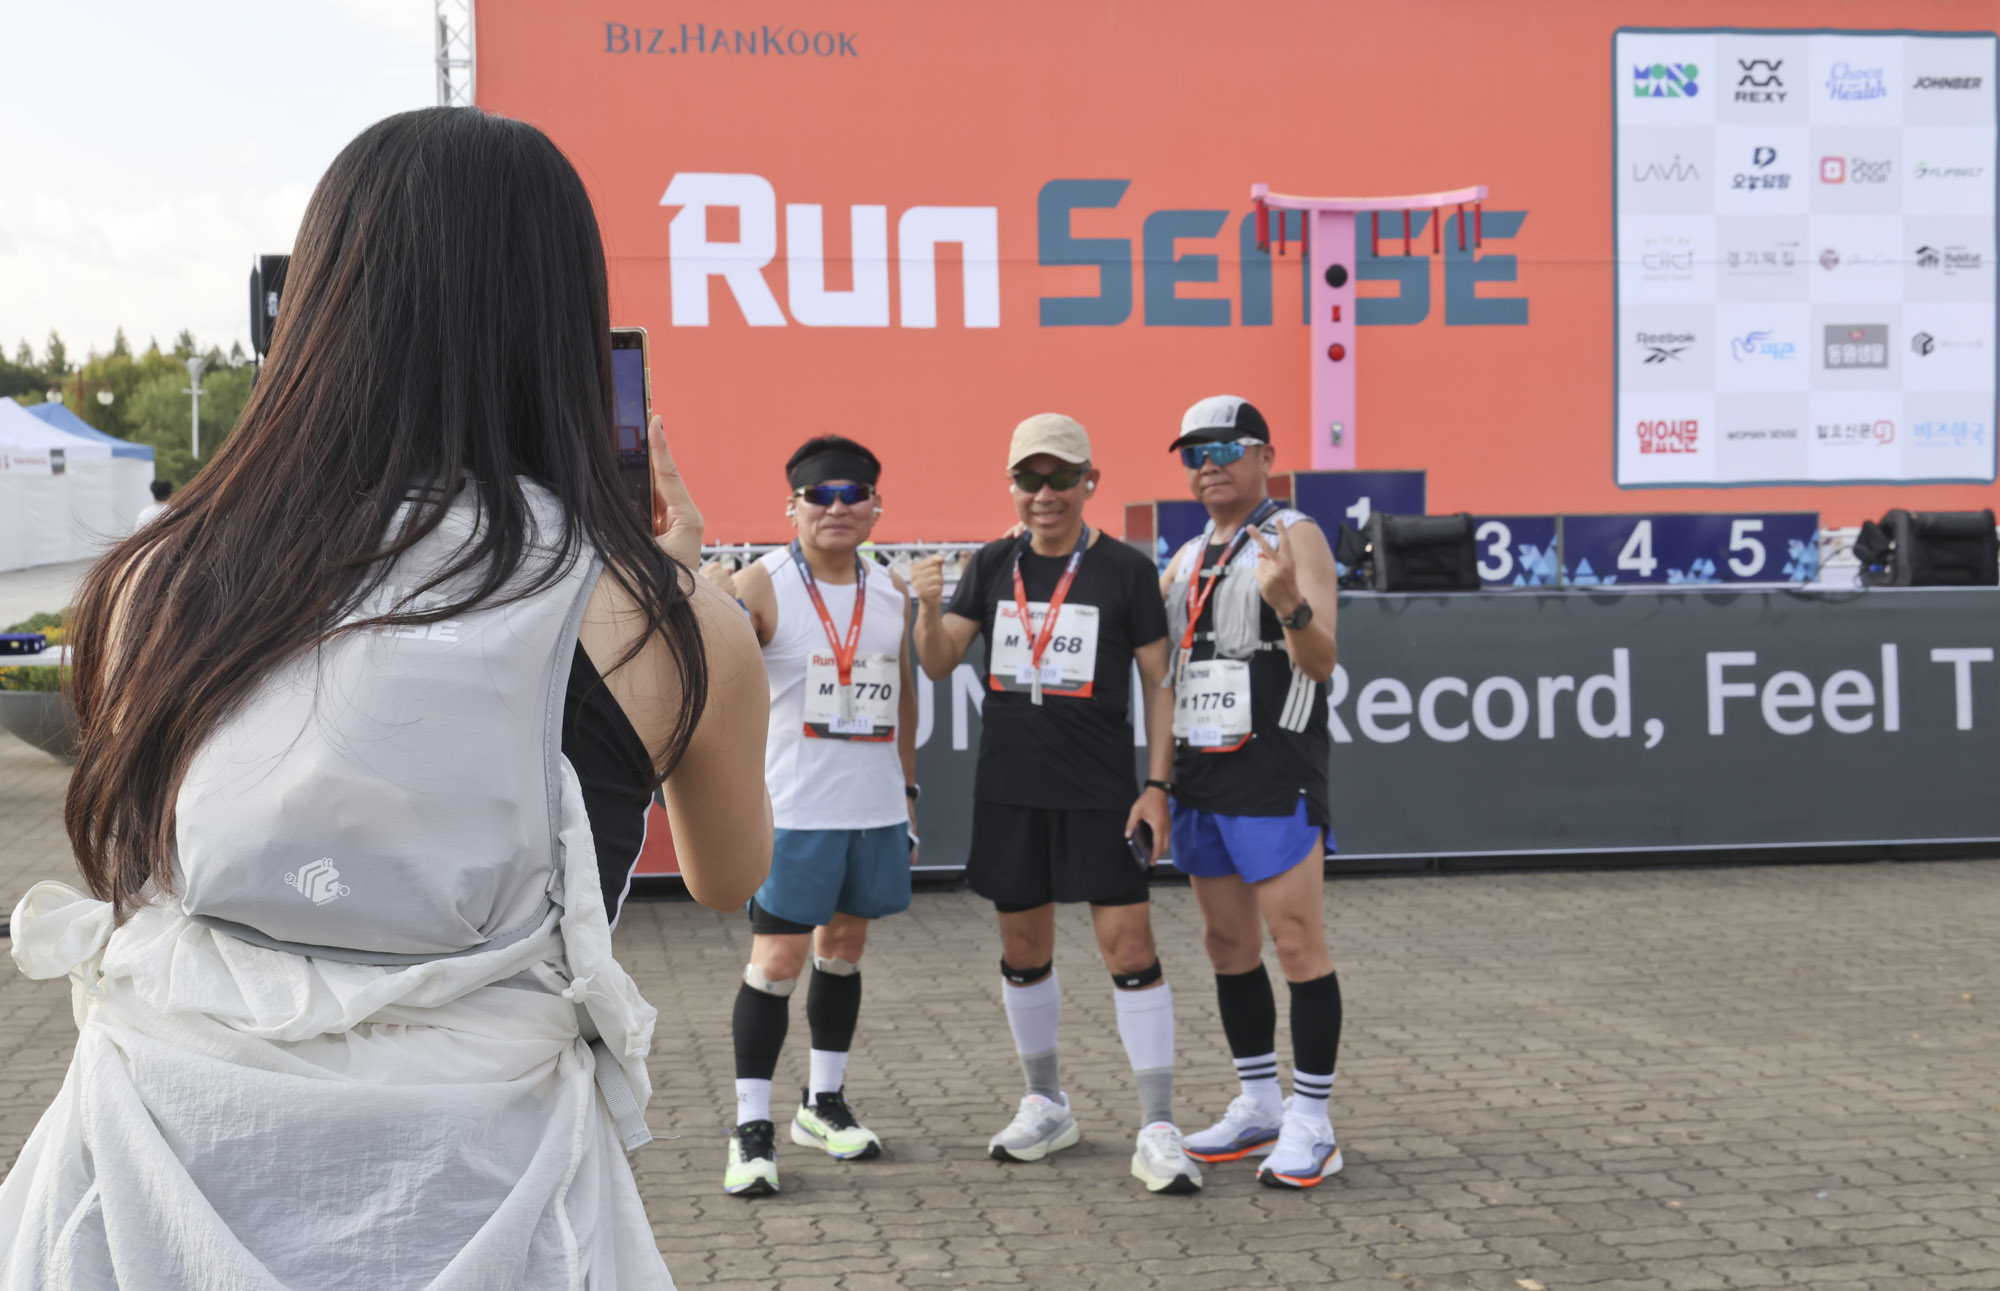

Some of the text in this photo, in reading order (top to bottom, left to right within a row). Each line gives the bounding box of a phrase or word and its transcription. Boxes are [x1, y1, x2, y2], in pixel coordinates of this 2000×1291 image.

[1734, 91, 1788, 103] REXY
[660, 172, 1000, 328] Run
[1636, 332, 1695, 344] Reebok
[1475, 520, 1514, 581] 3
[1617, 520, 1658, 577] 4
[1727, 519, 1767, 575] 5
[812, 655, 836, 667] Run
[819, 682, 835, 696] M
[1192, 691, 1236, 711] 1776
[1706, 643, 1901, 736] Feel
